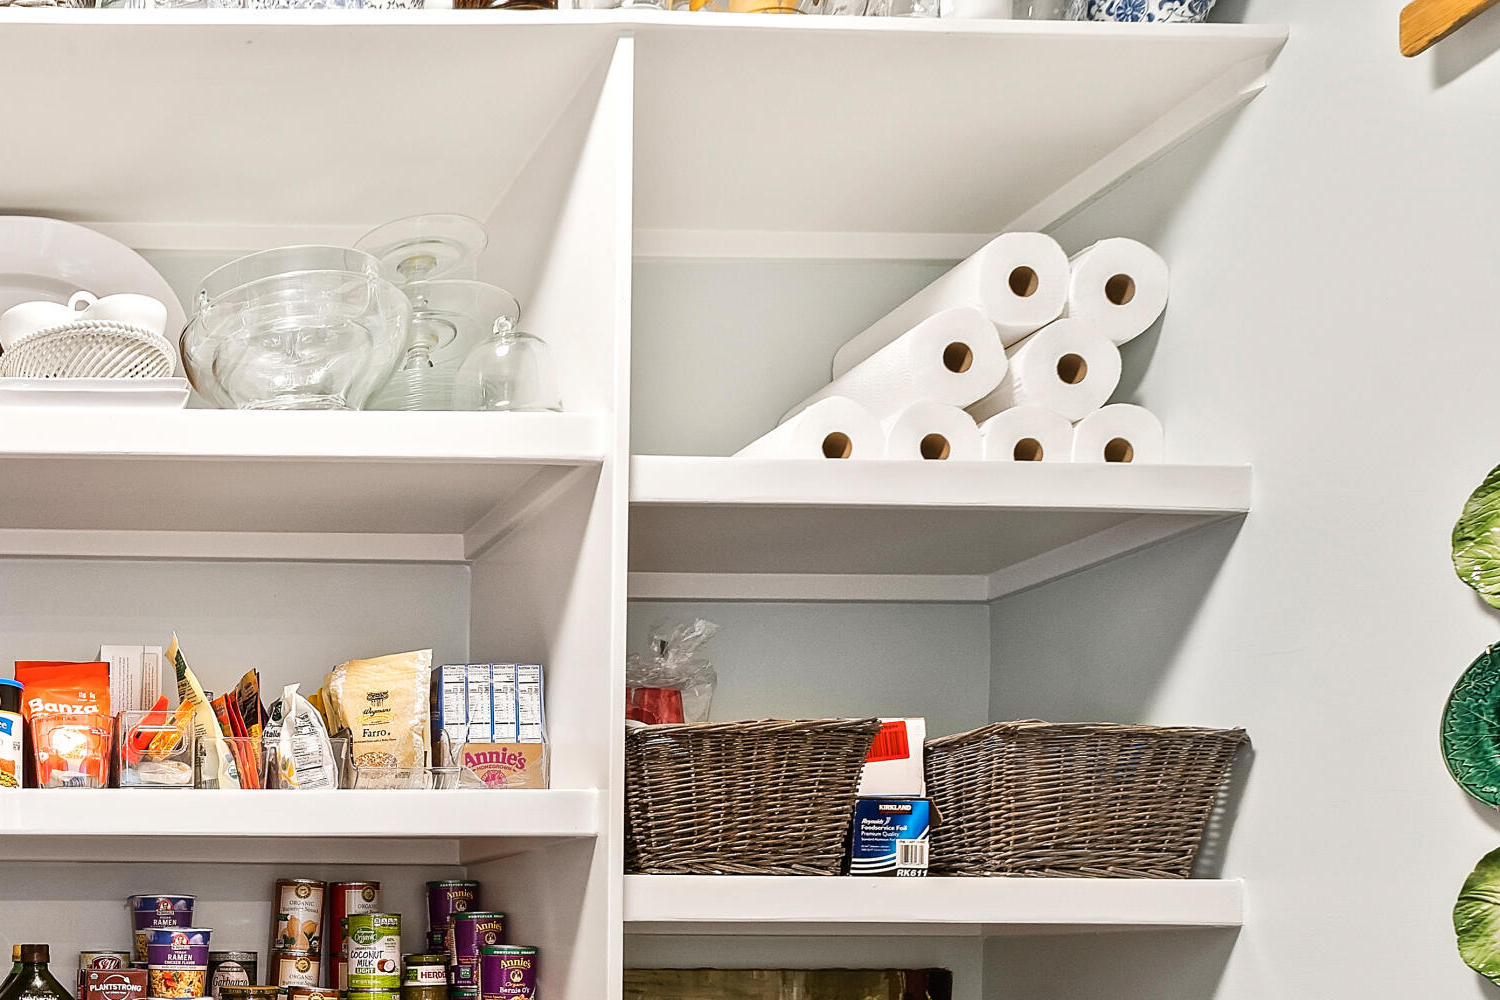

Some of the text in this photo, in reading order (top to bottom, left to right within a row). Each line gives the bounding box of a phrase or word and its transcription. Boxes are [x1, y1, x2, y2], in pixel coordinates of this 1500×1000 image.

[27, 698, 100, 714] Banza
[362, 729, 388, 738] Farro
[464, 747, 527, 770] Annie's
[896, 869, 928, 877] RK611
[354, 934, 377, 944] Organic
[167, 953, 193, 961] RAMEN
[350, 950, 384, 959] COCONUT
[501, 958, 531, 968] Annie's
[90, 983, 142, 992] PLANTSTRONG
